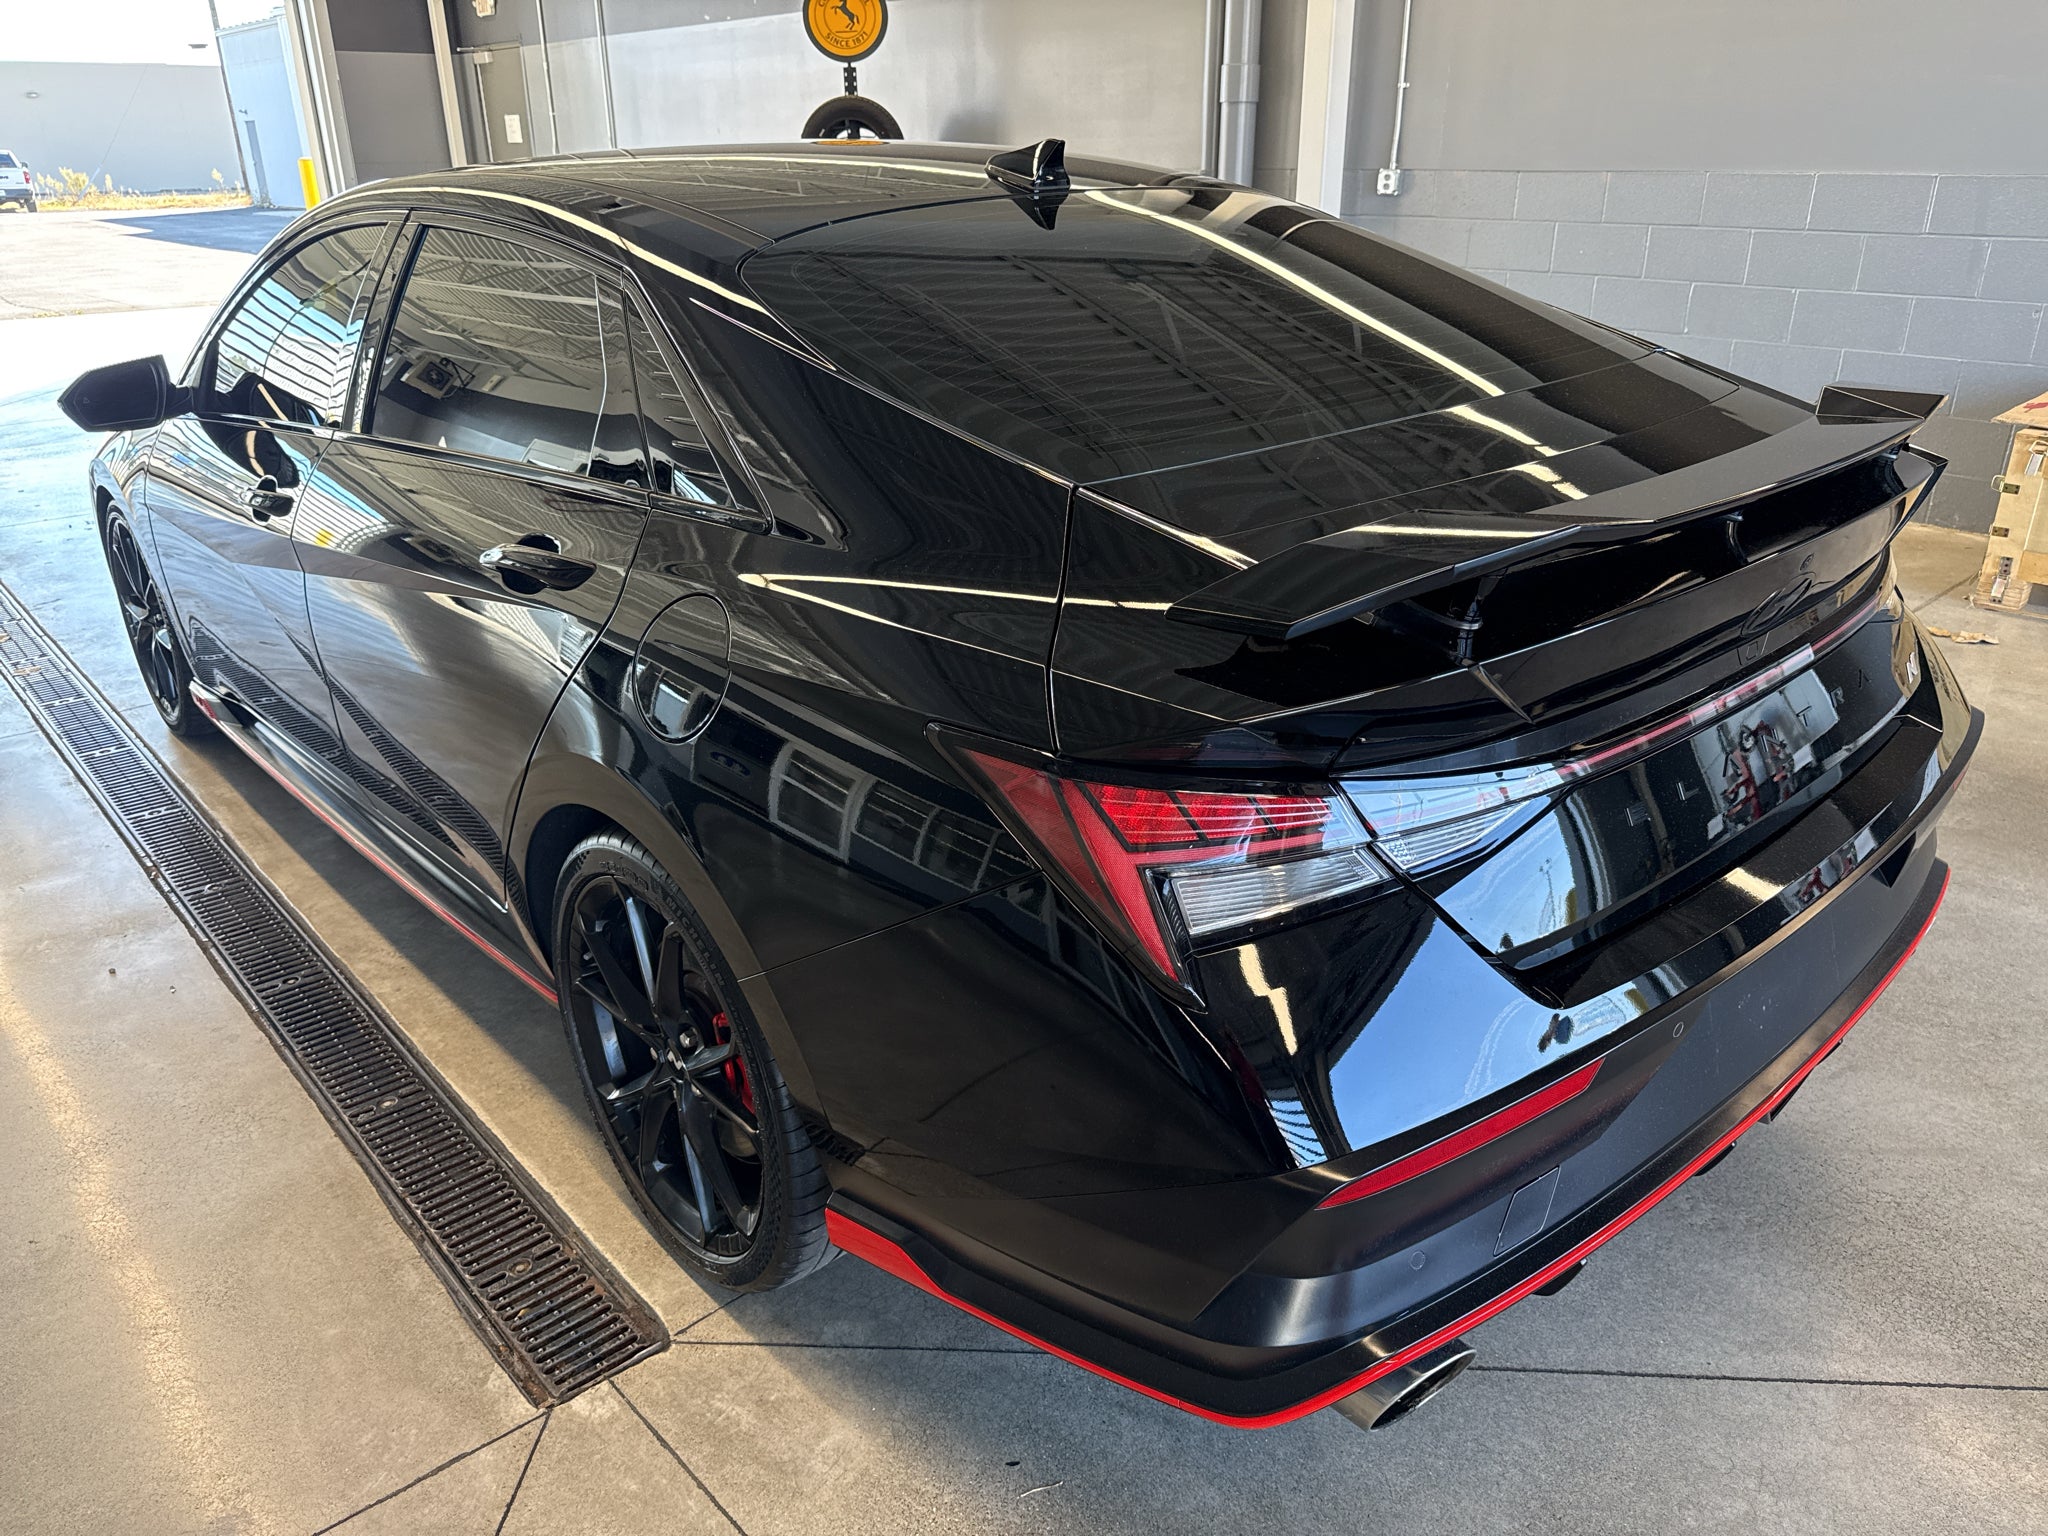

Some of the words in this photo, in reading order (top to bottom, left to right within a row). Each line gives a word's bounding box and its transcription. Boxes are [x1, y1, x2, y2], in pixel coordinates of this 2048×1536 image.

[825, 32, 851, 48] SINCE
[852, 31, 868, 46] 1871
[1906, 652, 1918, 684] N
[1623, 668, 1873, 828] ELANTRA
[666, 897, 726, 986] MICHELIN
